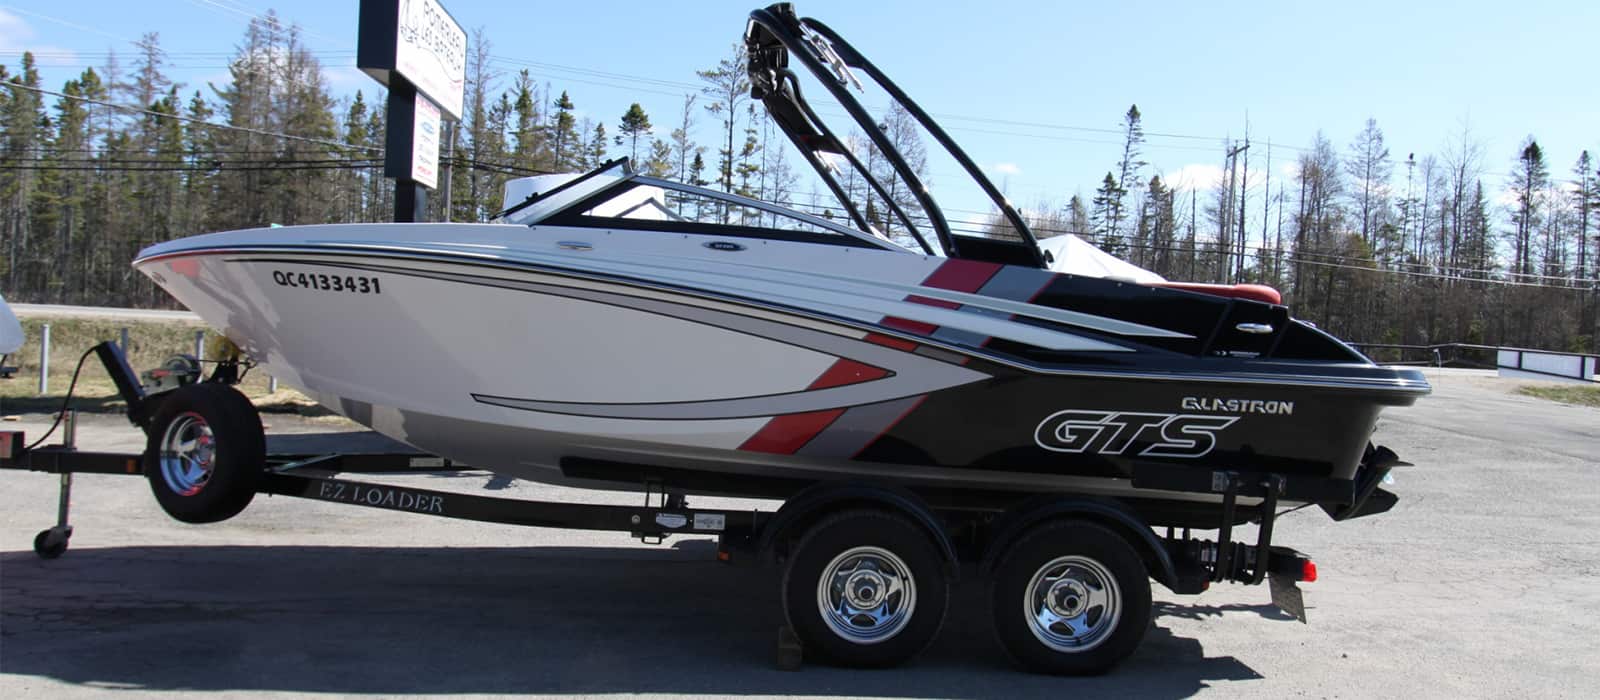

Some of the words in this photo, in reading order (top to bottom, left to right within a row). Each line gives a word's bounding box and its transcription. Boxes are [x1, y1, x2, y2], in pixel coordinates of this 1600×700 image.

[273, 265, 381, 294] QC4133431
[1182, 396, 1295, 415] GLASTRON
[1034, 409, 1241, 458] GTS
[320, 480, 345, 500] EZ
[352, 486, 443, 513] LOADER
